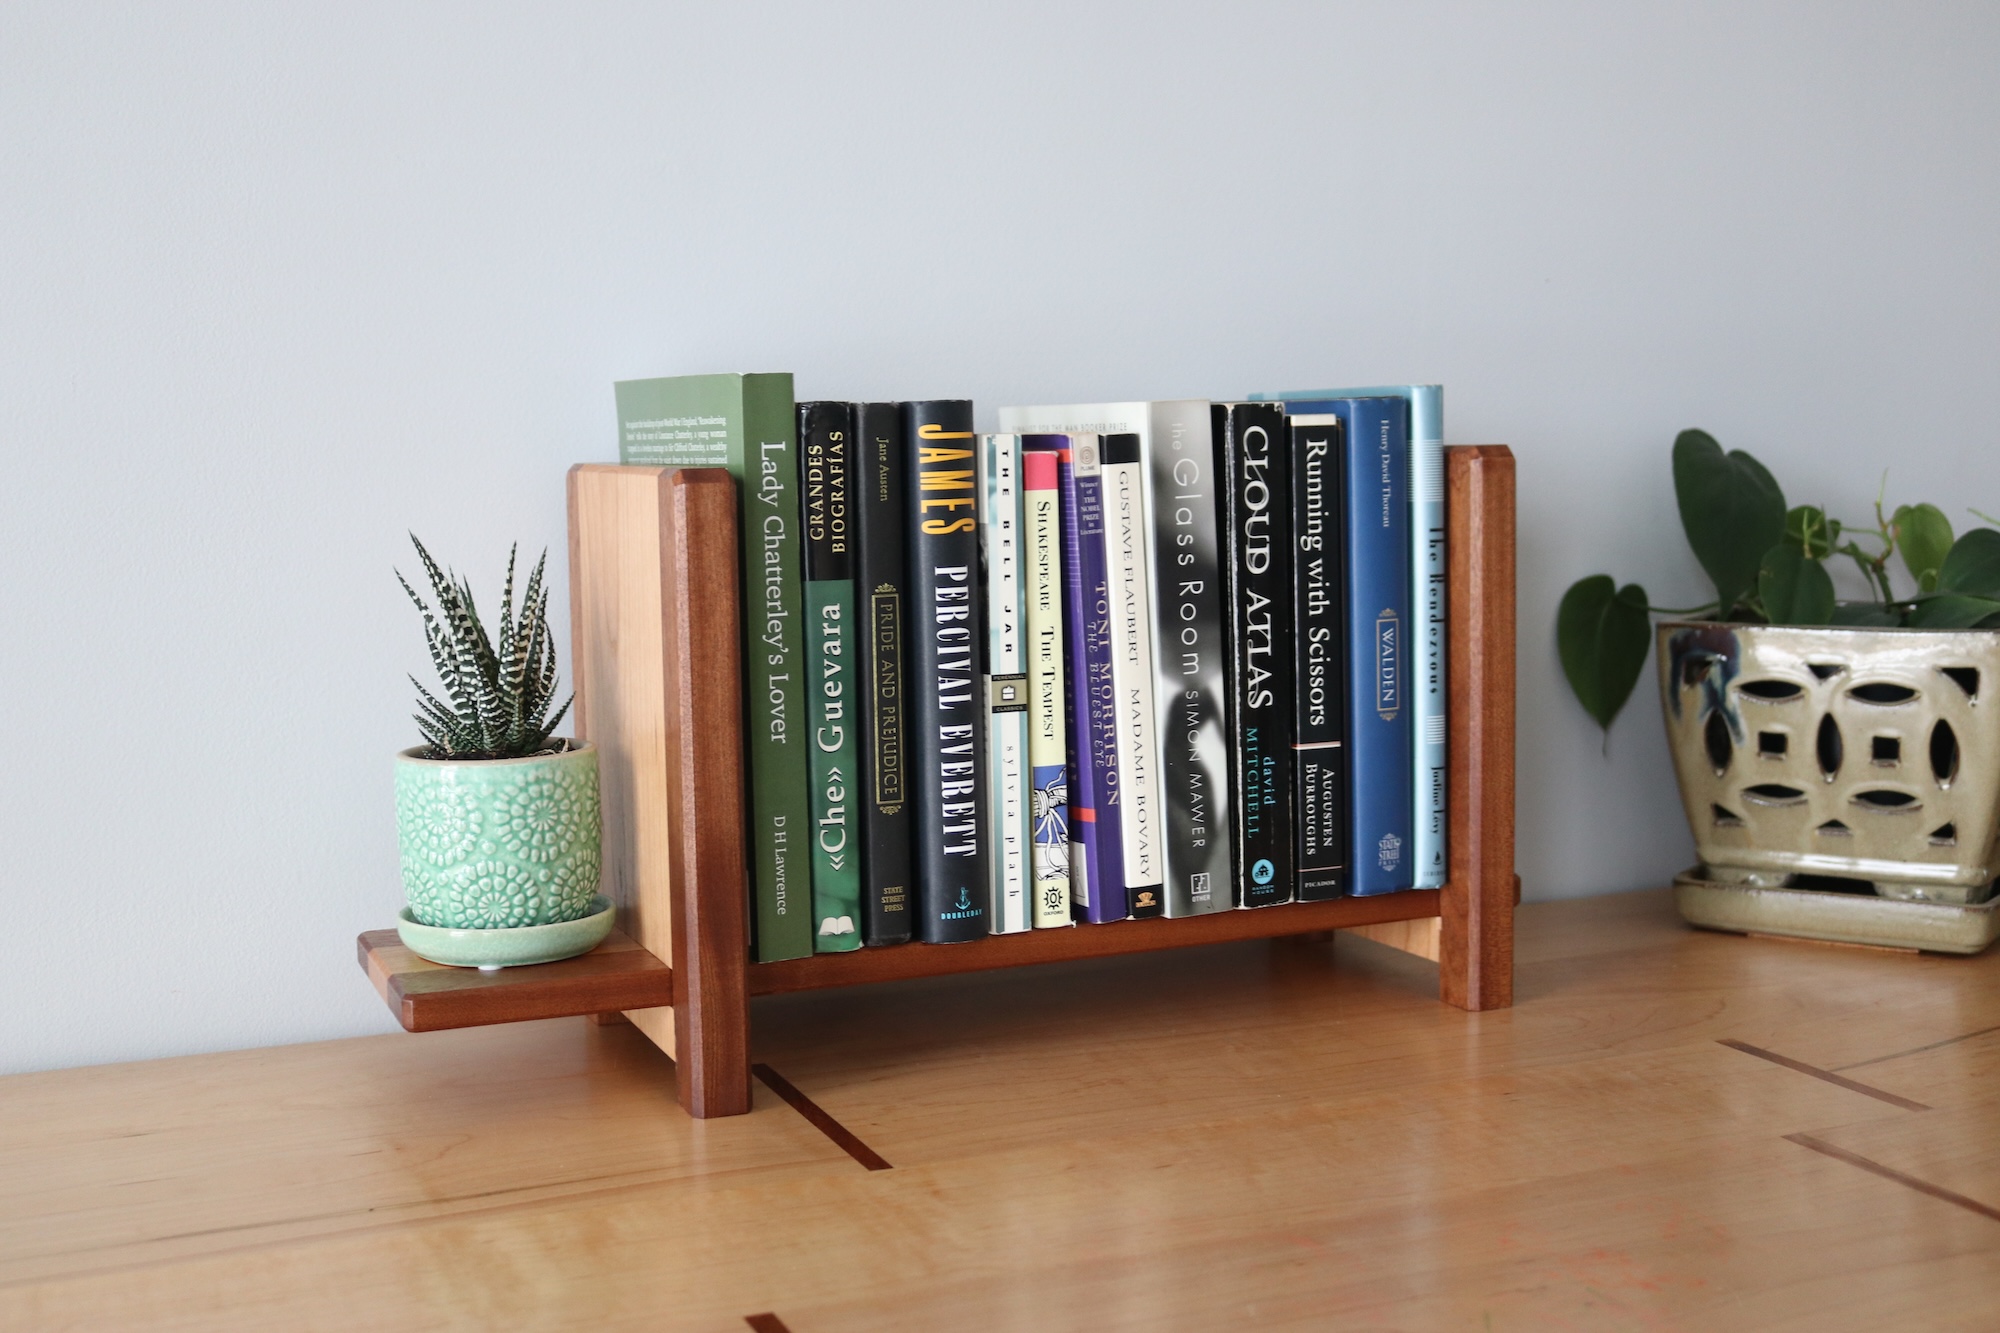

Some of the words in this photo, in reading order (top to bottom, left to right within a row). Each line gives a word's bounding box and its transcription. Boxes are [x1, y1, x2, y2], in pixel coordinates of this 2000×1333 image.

[875, 436, 890, 461] Jane
[1081, 423, 1106, 432] BOOKER
[1109, 422, 1128, 431] PRIZE
[1379, 419, 1389, 451] Henry
[757, 441, 787, 507] Lady
[808, 444, 825, 541] GRANDES
[828, 430, 846, 554] BIOGRAFÍAS
[879, 463, 890, 502] Austen
[917, 423, 977, 535] JAMES
[1001, 449, 1010, 496] THE
[1242, 425, 1271, 575] CLOUD
[1300, 438, 1330, 552] Running
[1382, 453, 1391, 483] David
[1119, 470, 1133, 561] GUSTAVE
[1173, 458, 1203, 566] Glass
[1382, 485, 1392, 528] Thoreau
[1003, 520, 1011, 582] BELL
[1037, 500, 1051, 611] SHAKESPEARE
[1308, 557, 1331, 616] with
[762, 515, 789, 665] Chatterley's
[1095, 581, 1109, 646] TONI
[1124, 566, 1138, 666] FLAUBERT
[880, 603, 895, 652] PRIDE
[934, 566, 973, 711] PERCIVAL
[1004, 605, 1013, 653] JAR
[1087, 622, 1098, 652] THE
[1178, 580, 1205, 675] Room
[1246, 588, 1273, 710] ATLAS
[817, 603, 845, 753] Guevara
[882, 659, 896, 699] AND
[1090, 662, 1102, 730] BLUEST
[1308, 627, 1331, 727] Scissors
[1382, 628, 1395, 702] WALDEN
[769, 673, 789, 744] Lover
[1042, 665, 1055, 740] TEMPEST
[1099, 662, 1119, 806] MORRISON
[1130, 688, 1146, 787] MADAME
[1185, 690, 1201, 762] SIMON
[882, 706, 898, 796] PREJUDICE
[1002, 745, 1018, 819] sylvia
[1094, 735, 1105, 768] EYE
[1246, 727, 1260, 839] MITCHELL
[1263, 756, 1276, 806] david
[1431, 766, 1445, 807] Justine
[773, 815, 786, 827] D
[818, 766, 846, 872] «Che»
[939, 723, 977, 858] EVERETT
[1189, 772, 1206, 848] MAWER
[1305, 763, 1318, 856] BURROUGHS
[1322, 768, 1335, 847] AUGUSTEN
[774, 832, 787, 844] H
[1005, 836, 1020, 898] plath
[1136, 795, 1151, 878] BOVARY
[774, 847, 787, 916] Lawrence
[880, 895, 906, 903] STREET
[883, 886, 904, 894] STATE
[884, 904, 904, 913] PRESS
[940, 908, 983, 920] DOUBLEDAY
[1192, 894, 1211, 903] OTHER
[1304, 879, 1336, 888] PICADOR
